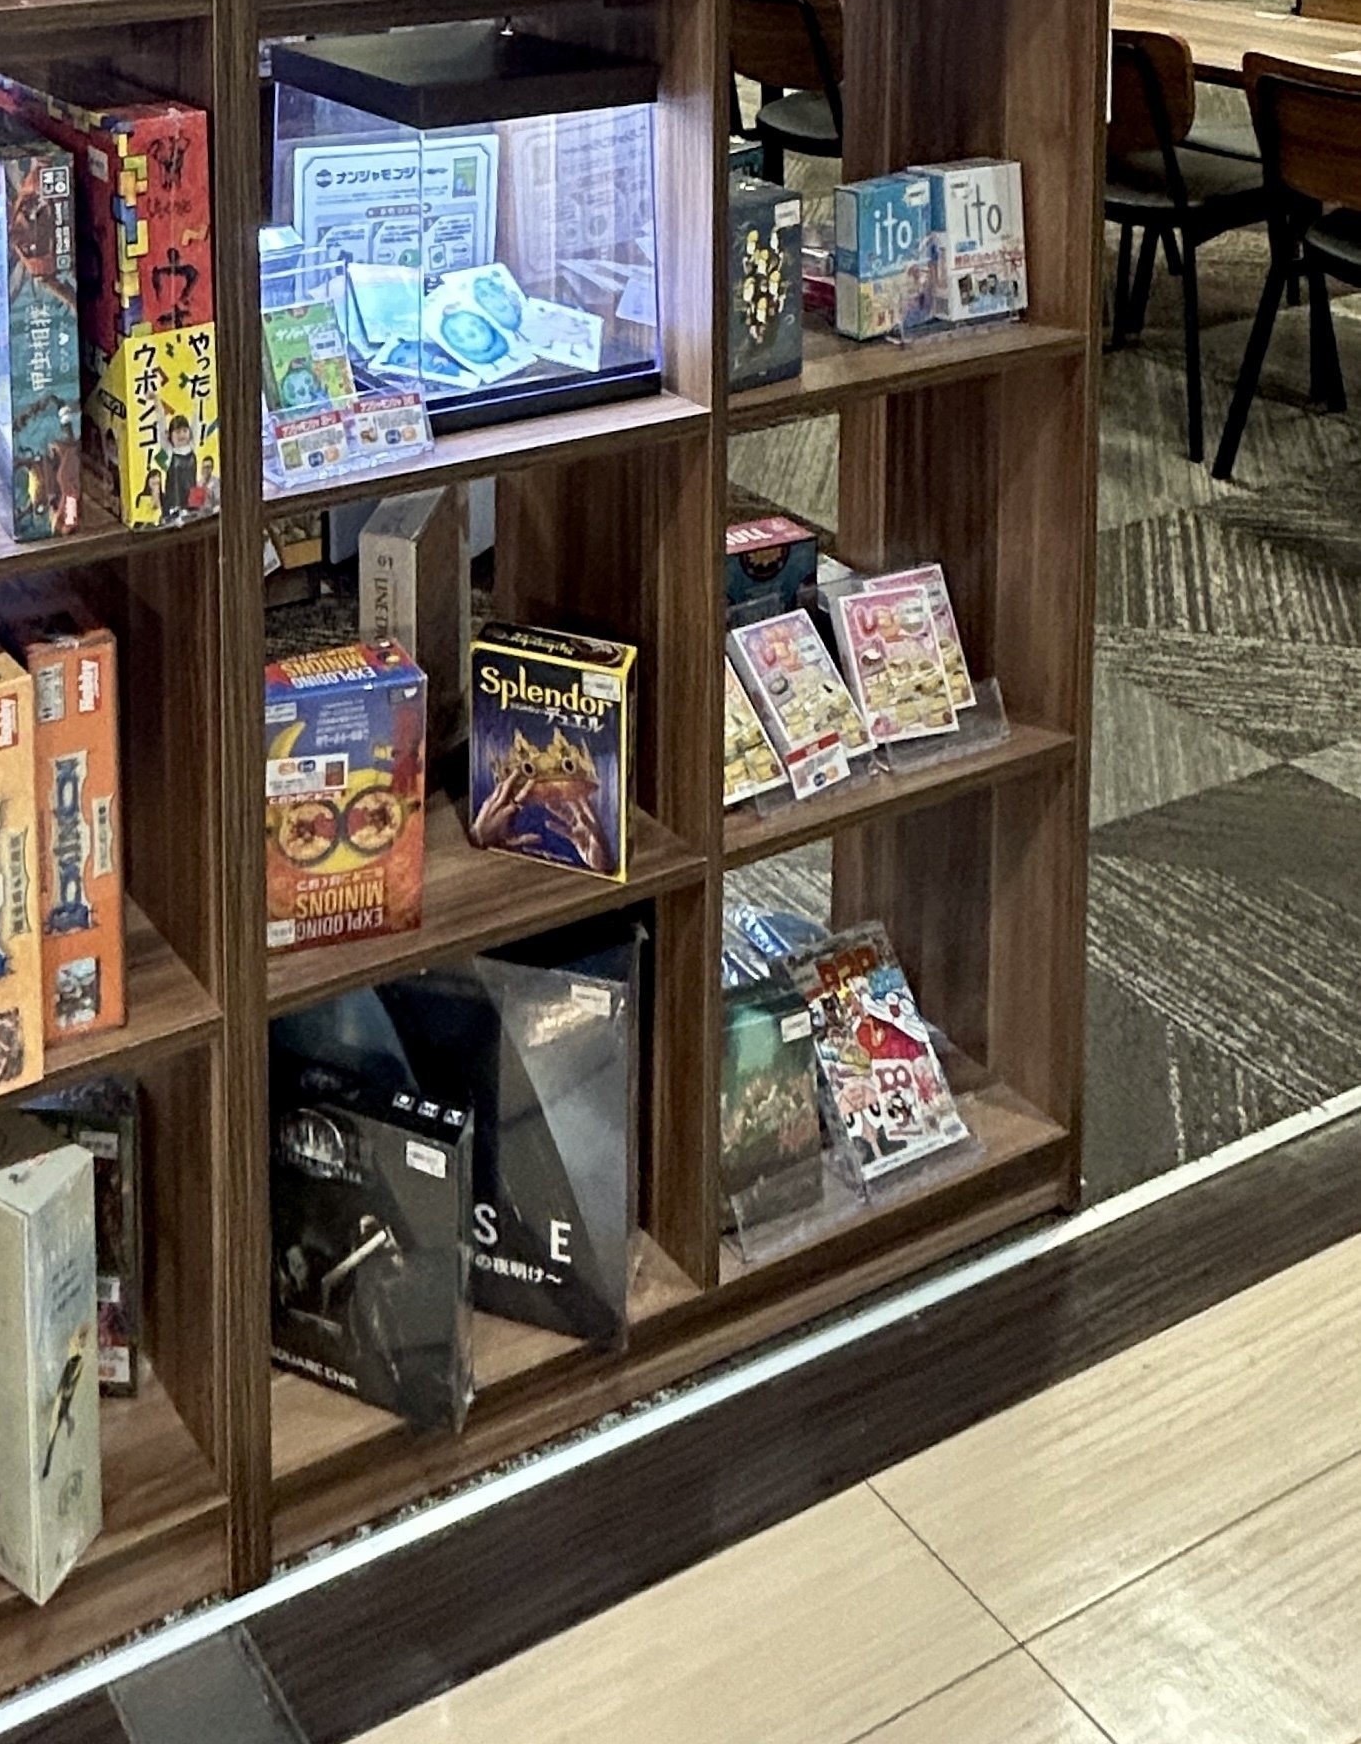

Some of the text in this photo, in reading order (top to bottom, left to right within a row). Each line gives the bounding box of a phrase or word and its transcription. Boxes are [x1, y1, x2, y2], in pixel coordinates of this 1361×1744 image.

[334, 164, 418, 185] ナンジャモンジ
[874, 201, 913, 263] ito
[963, 182, 1003, 247] ito
[131, 343, 159, 471] ウボンゴ!
[280, 651, 368, 677] MINIONS
[290, 666, 378, 689] EXPLODING
[479, 664, 613, 717] Splendor
[295, 881, 384, 919] MINIONS
[296, 907, 383, 940] EXPLODING
